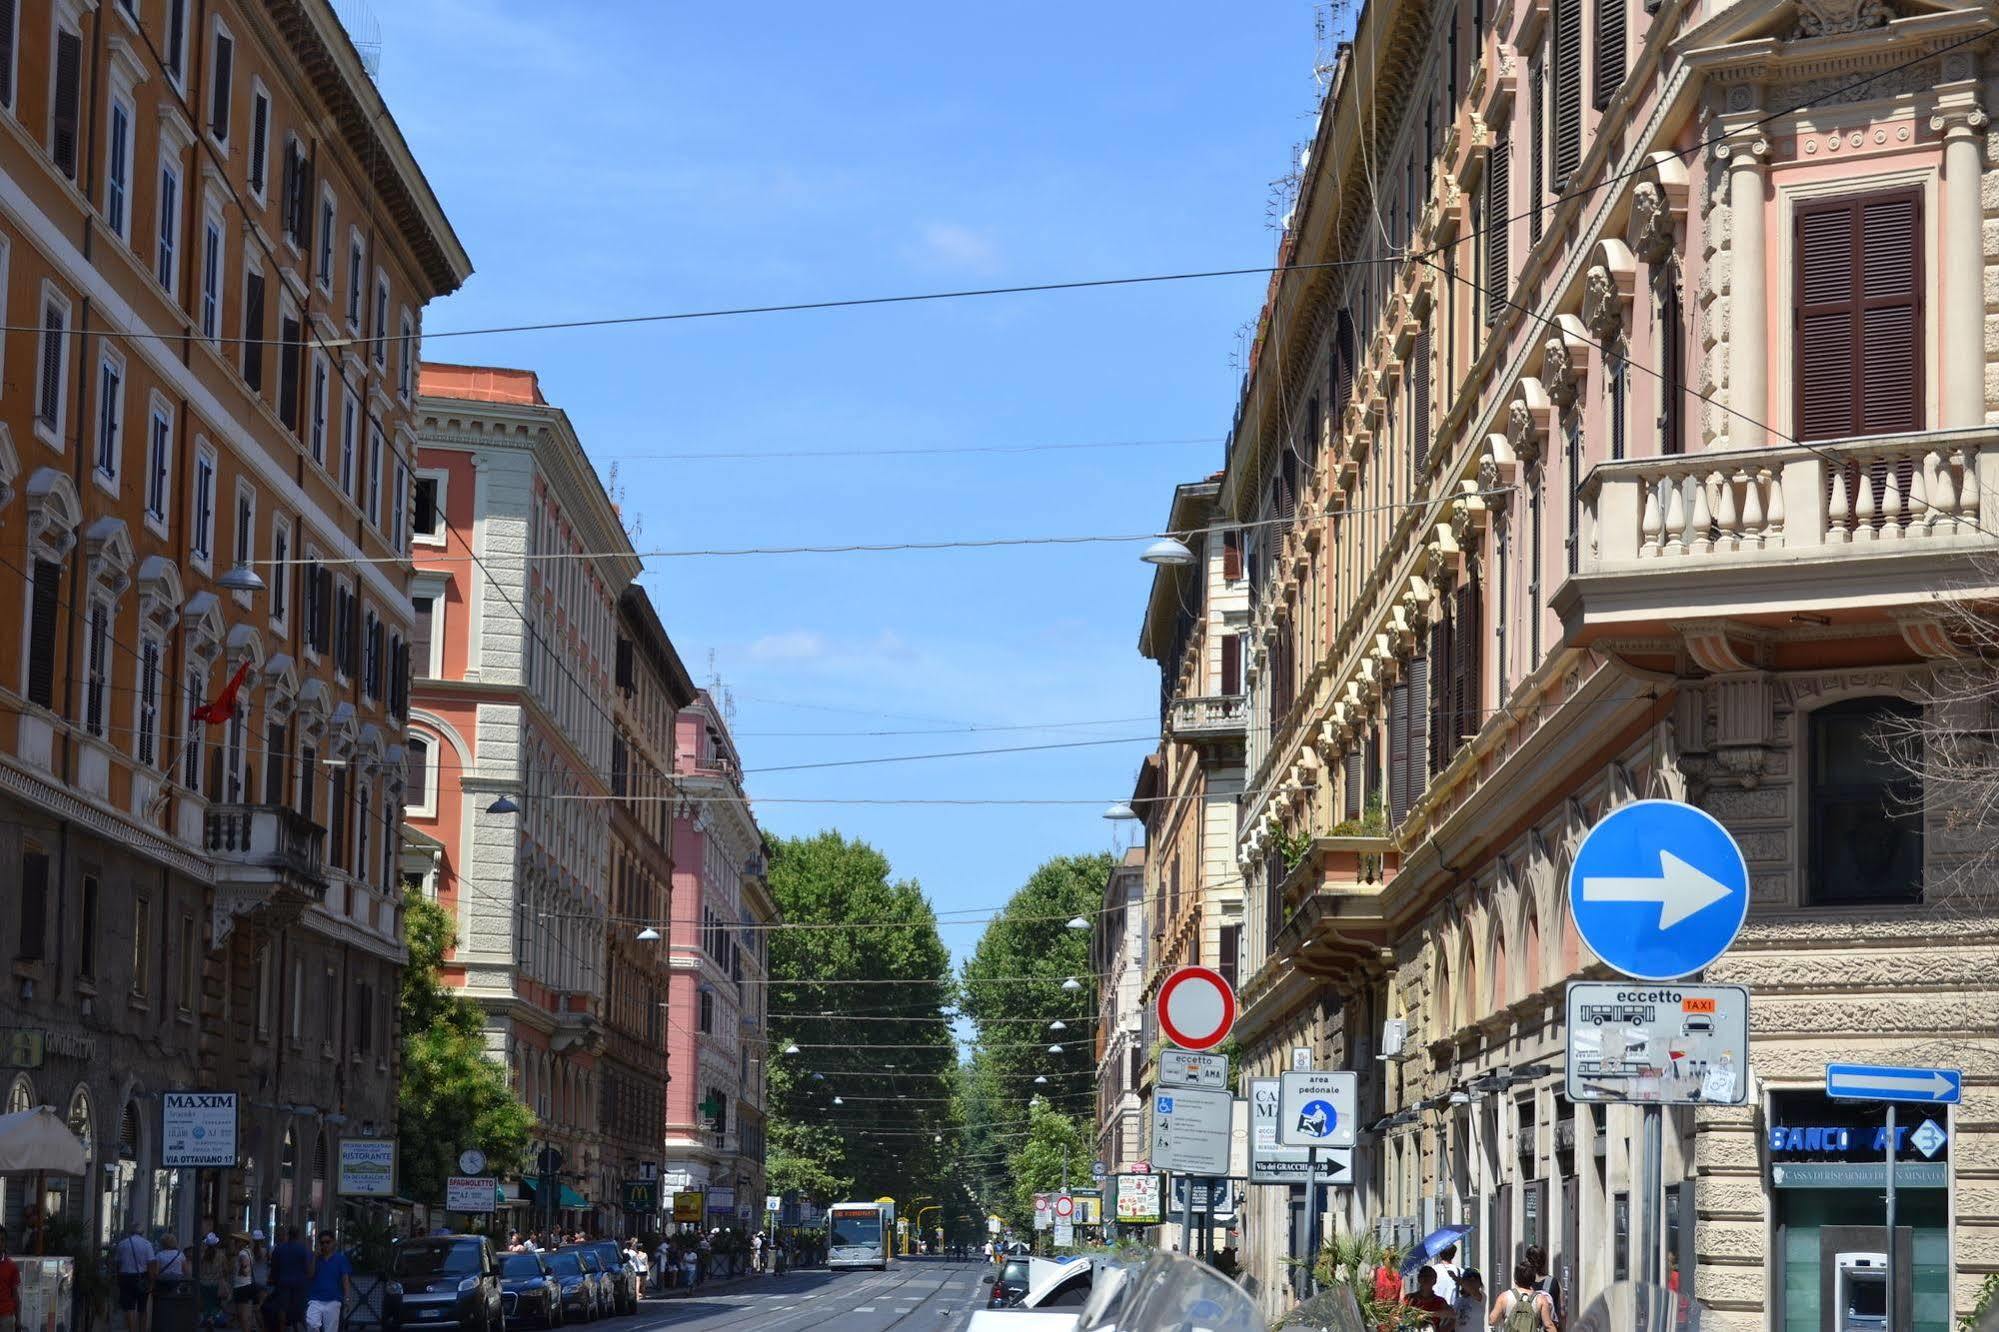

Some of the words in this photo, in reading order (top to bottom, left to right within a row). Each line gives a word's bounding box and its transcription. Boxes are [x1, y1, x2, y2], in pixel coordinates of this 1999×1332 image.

[1616, 989, 1683, 1004] eccetto
[1686, 999, 1712, 1010] TAXI
[1175, 1056, 1213, 1065] eccetto
[1205, 1069, 1220, 1078] AMA
[1299, 1086, 1340, 1094] pedonale
[167, 1095, 233, 1109] MAXIM
[166, 1155, 179, 1164] VIA
[180, 1155, 222, 1164] OTTAVIANO
[223, 1155, 233, 1164] 17
[342, 1152, 393, 1161] RISTORANTE
[1256, 1162, 1267, 1170] Via
[449, 1178, 494, 1187] SPAGNOLETTO
